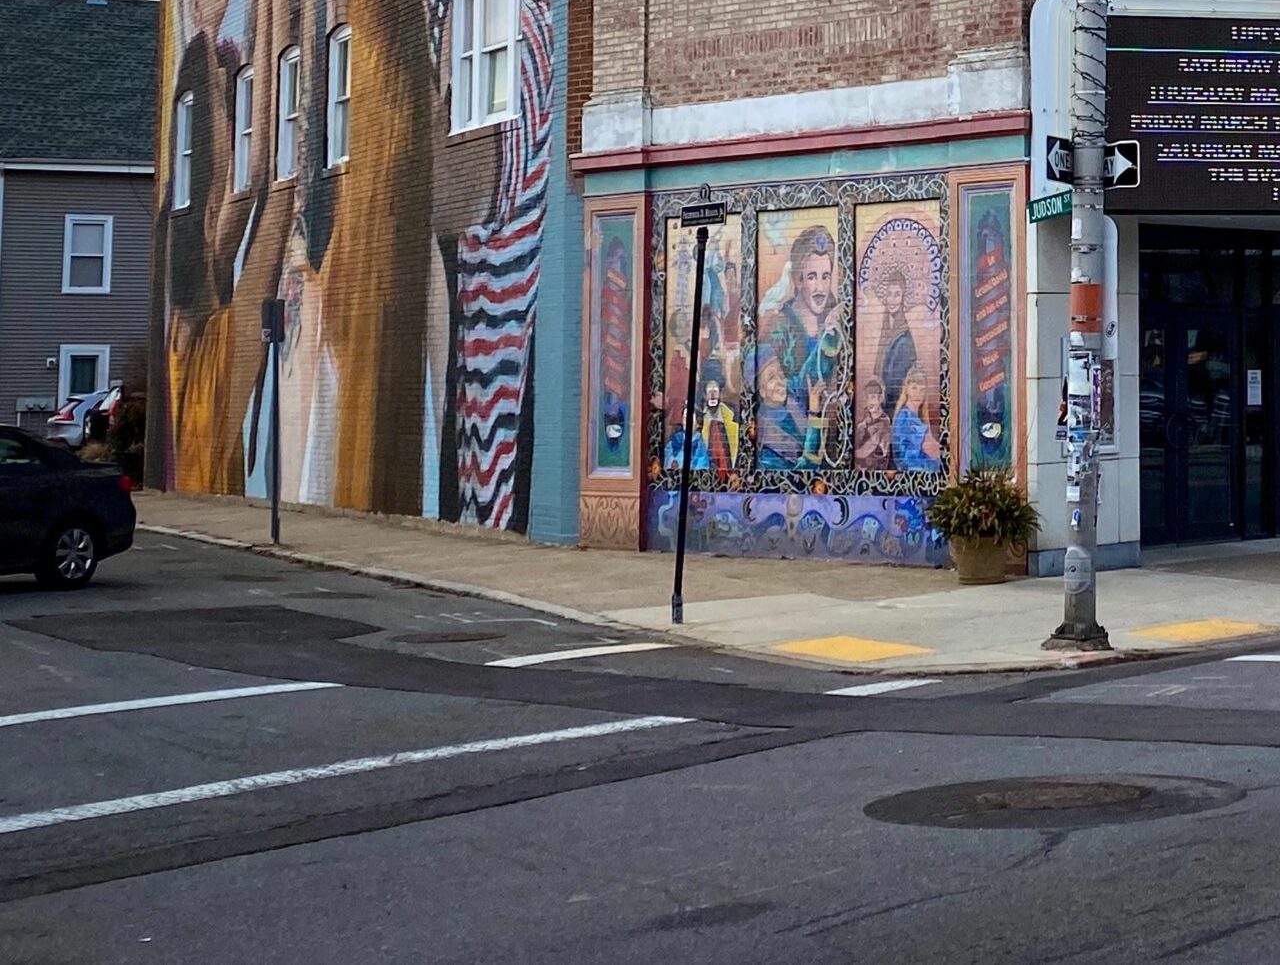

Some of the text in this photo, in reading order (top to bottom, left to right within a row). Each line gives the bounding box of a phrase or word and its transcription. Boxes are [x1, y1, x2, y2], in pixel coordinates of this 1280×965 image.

[1178, 57, 1274, 73] SATURDAY
[1130, 113, 1196, 130] FRIDAY
[1200, 114, 1269, 131] MARCH
[1054, 150, 1071, 169] ONE
[1207, 167, 1245, 183] THE
[1031, 193, 1072, 220] JUDSON ST
